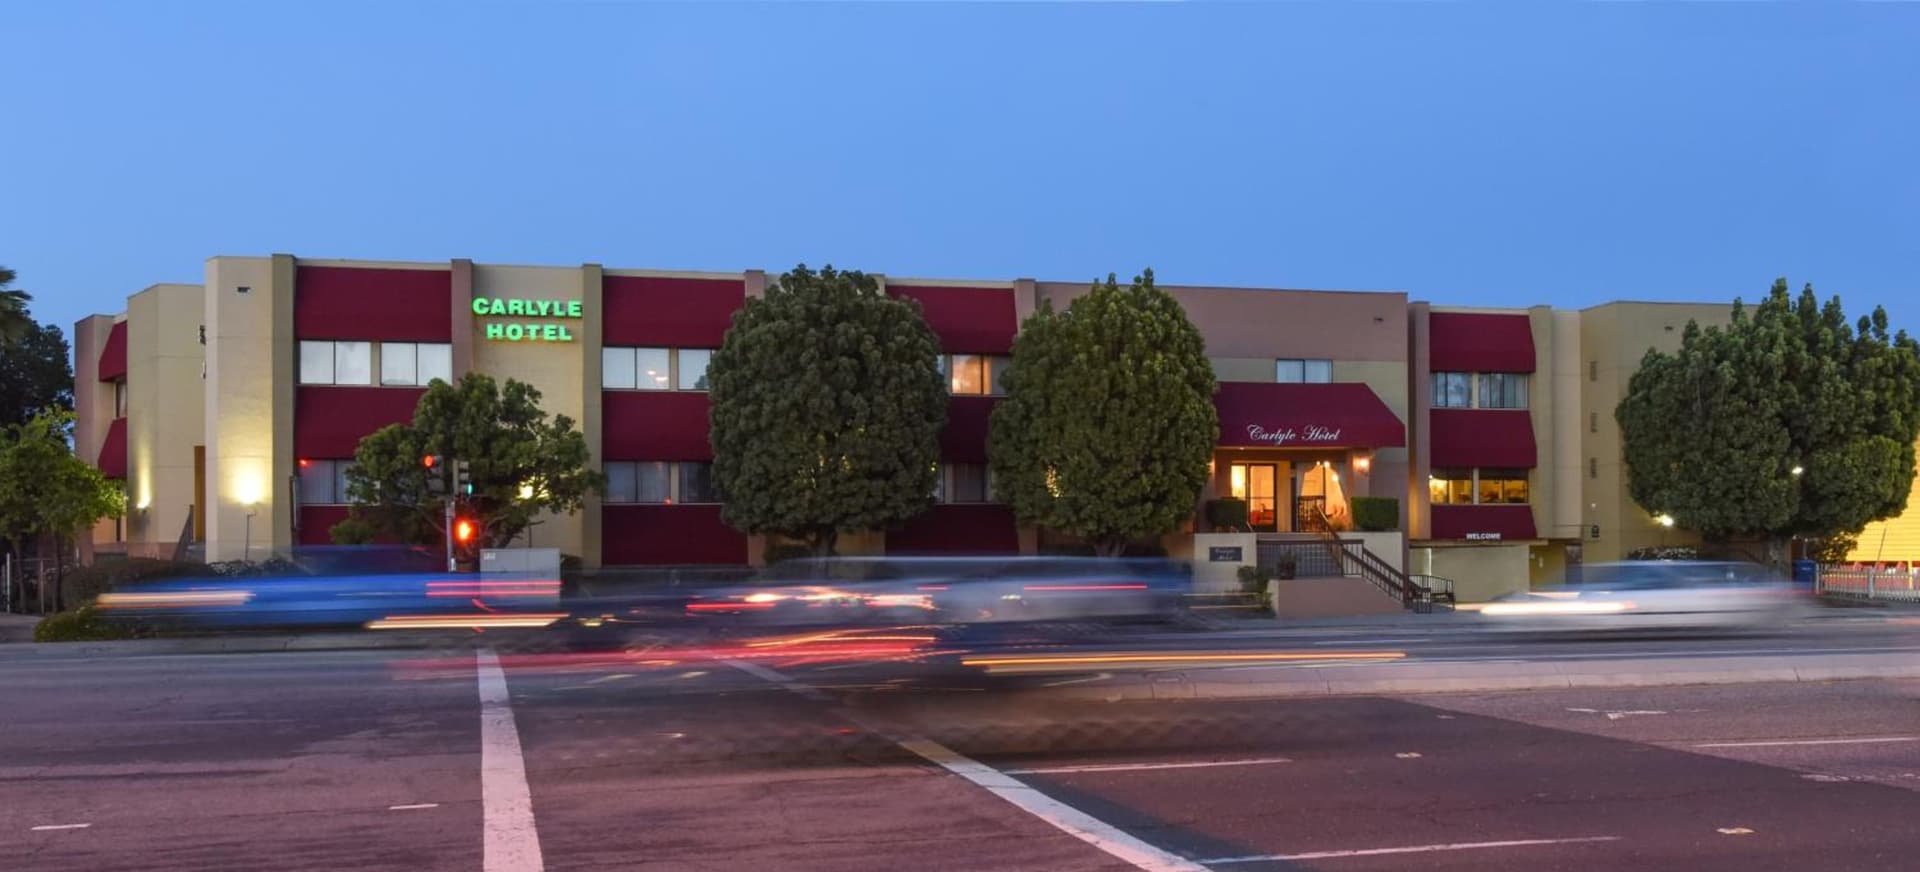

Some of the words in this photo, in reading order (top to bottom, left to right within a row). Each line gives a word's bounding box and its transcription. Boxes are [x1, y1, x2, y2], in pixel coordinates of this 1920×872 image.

[472, 297, 582, 317] CARLYLE
[486, 323, 573, 341] HOTEL
[1246, 424, 1296, 445] Carlyle
[1301, 424, 1340, 440] Hotel
[1466, 532, 1501, 540] WELCOME
